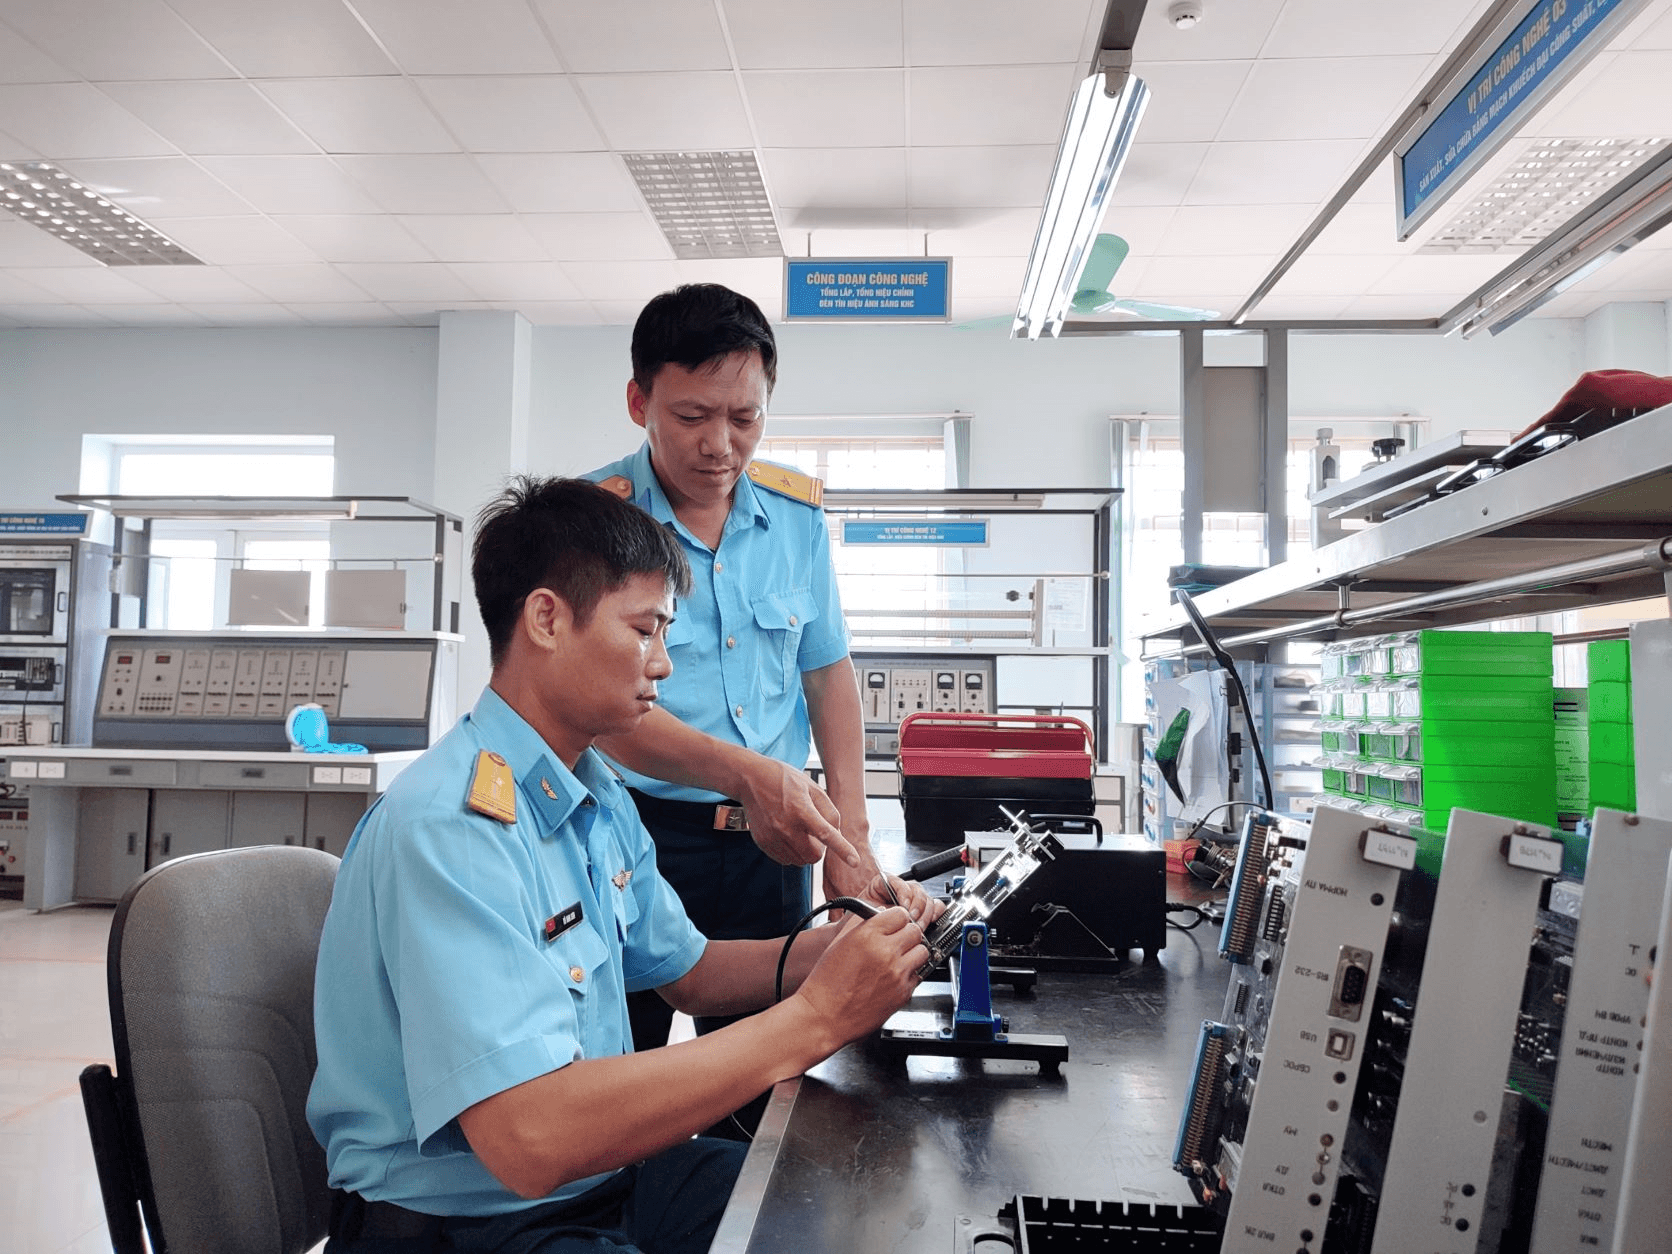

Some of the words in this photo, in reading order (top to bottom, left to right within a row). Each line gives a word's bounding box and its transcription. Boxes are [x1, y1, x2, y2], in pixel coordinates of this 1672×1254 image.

[1550, 25, 1571, 56] CÔNG
[1468, 91, 1477, 114] VỊ
[1478, 70, 1492, 103] TRÍ
[1494, 44, 1520, 86] CÔNG
[1522, 7, 1550, 56] NGHỆ
[1553, 0, 1567, 22] 03
[806, 271, 835, 285] CÔNG
[838, 273, 866, 287] ĐOẠN
[869, 271, 898, 285] CÔNG
[900, 271, 929, 287] NGHỆ
[1304, 879, 1316, 889] ПУ
[1318, 882, 1348, 896] НОРМА
[1294, 965, 1329, 981] RS-232
[1300, 1030, 1317, 1043] USB
[1282, 1059, 1311, 1074] СБРОС
[1595, 1063, 1625, 1077] КОНТР
[1262, 1182, 1286, 1196] ОТКЛ
